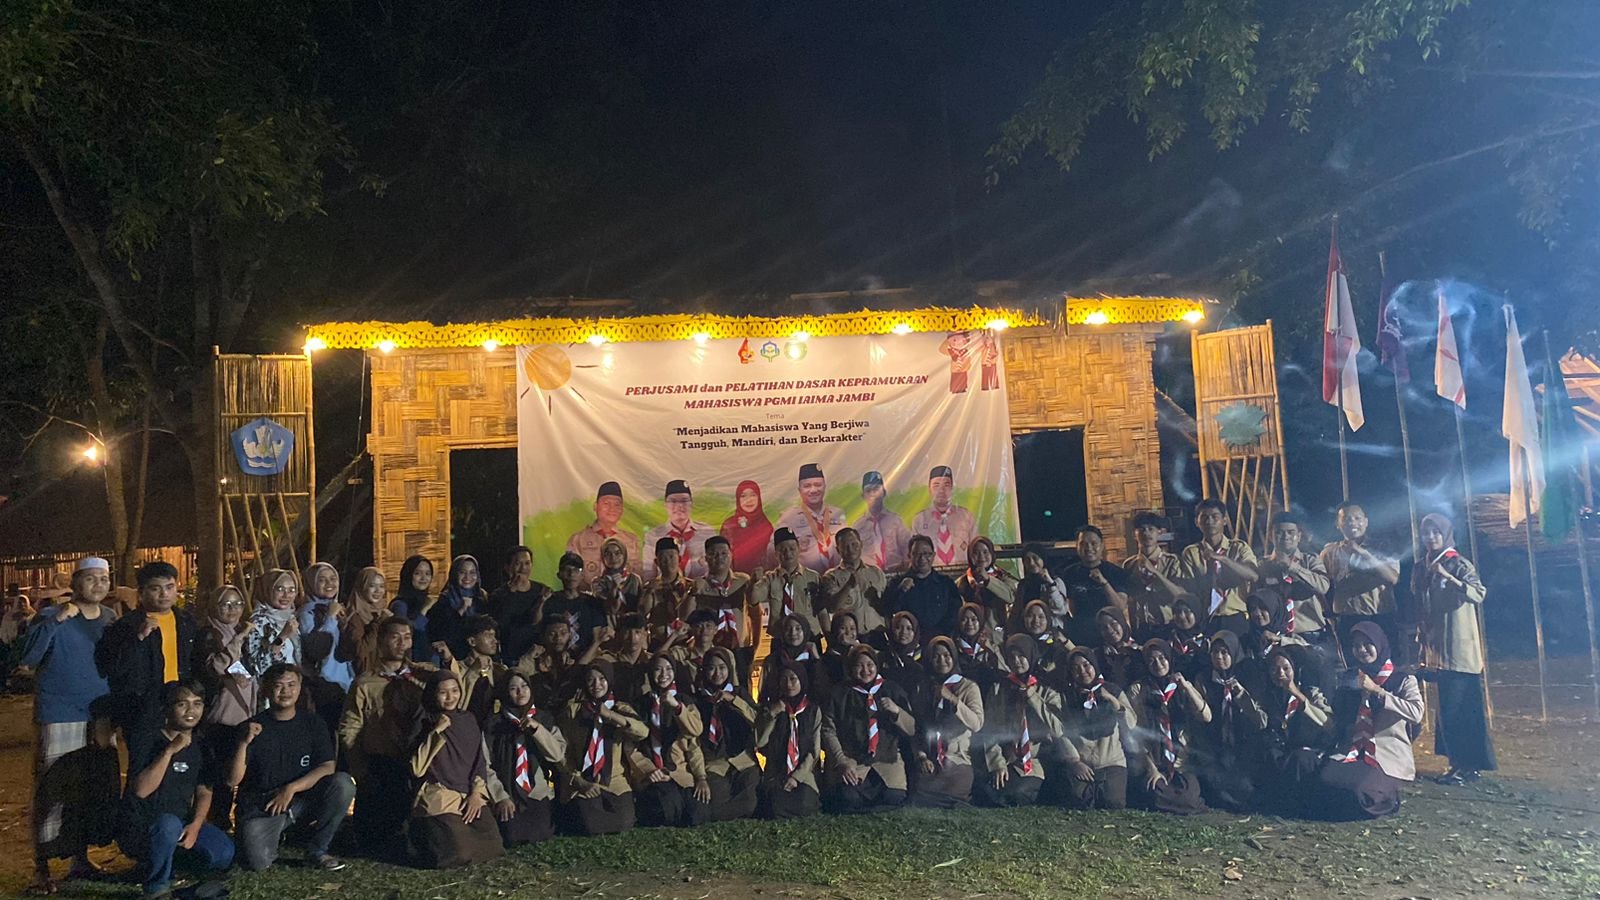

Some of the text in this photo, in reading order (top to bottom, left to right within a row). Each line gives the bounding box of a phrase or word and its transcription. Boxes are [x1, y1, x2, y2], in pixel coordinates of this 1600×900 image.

[625, 375, 929, 396] PERJUSAMI dan PELATIHAN DASAR KEPRAMUKAAN
[684, 392, 876, 409] MAHASISWA PGMI IAIMA JAMBI
[741, 423, 799, 433] Mahasiswa
[801, 421, 828, 431] Yang
[830, 419, 870, 430] Berjiwa
[680, 440, 730, 450] Tangguh,
[732, 437, 776, 448] Mandiri,
[778, 435, 798, 445] dan
